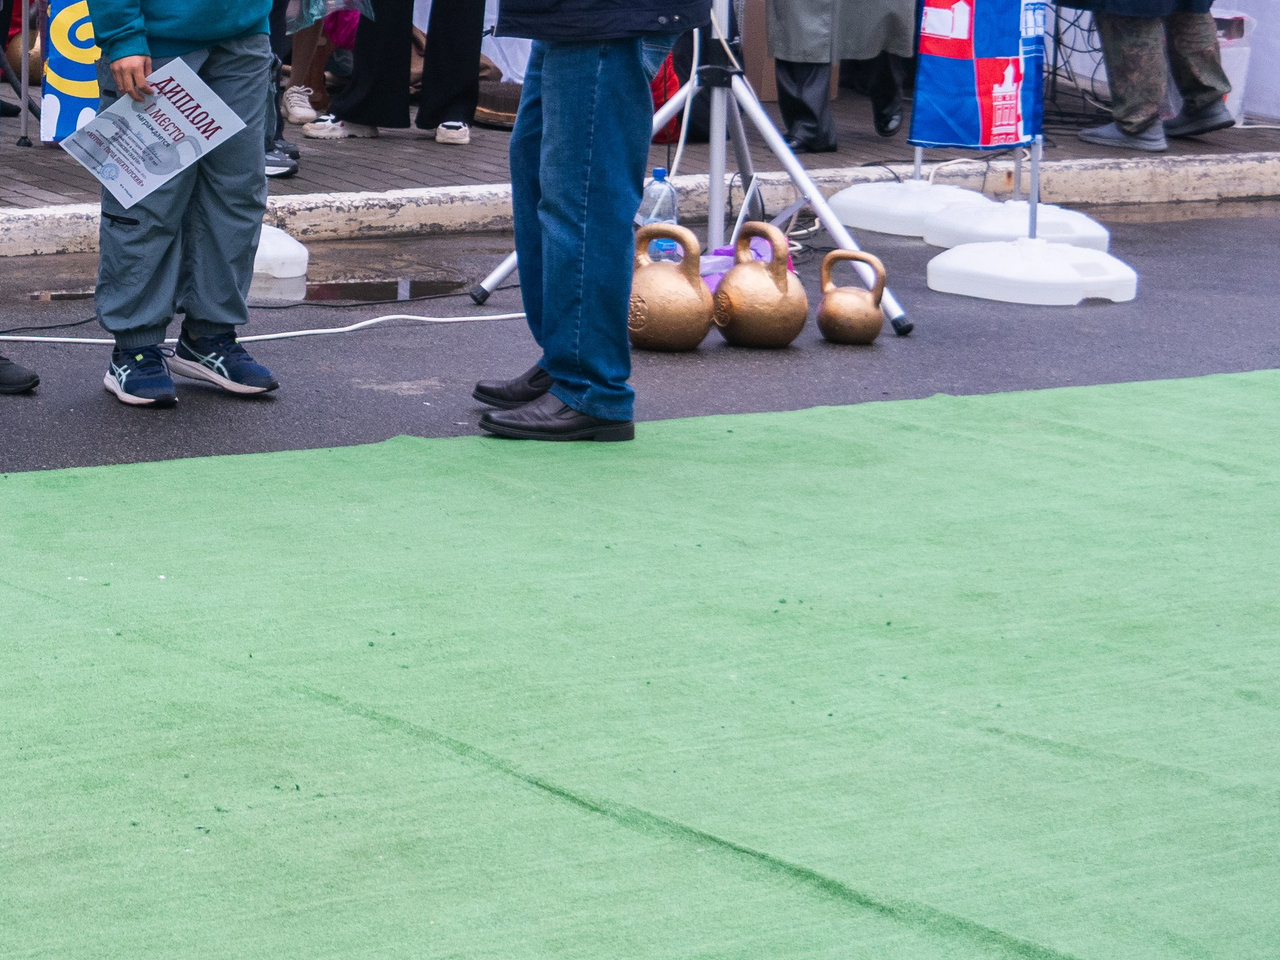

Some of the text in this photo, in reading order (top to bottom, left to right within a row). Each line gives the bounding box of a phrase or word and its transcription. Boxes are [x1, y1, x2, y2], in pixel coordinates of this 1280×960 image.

[148, 108, 187, 143] МЕСТО
[150, 76, 223, 141] ДИПЛОМ
[135, 113, 171, 148] награждается
